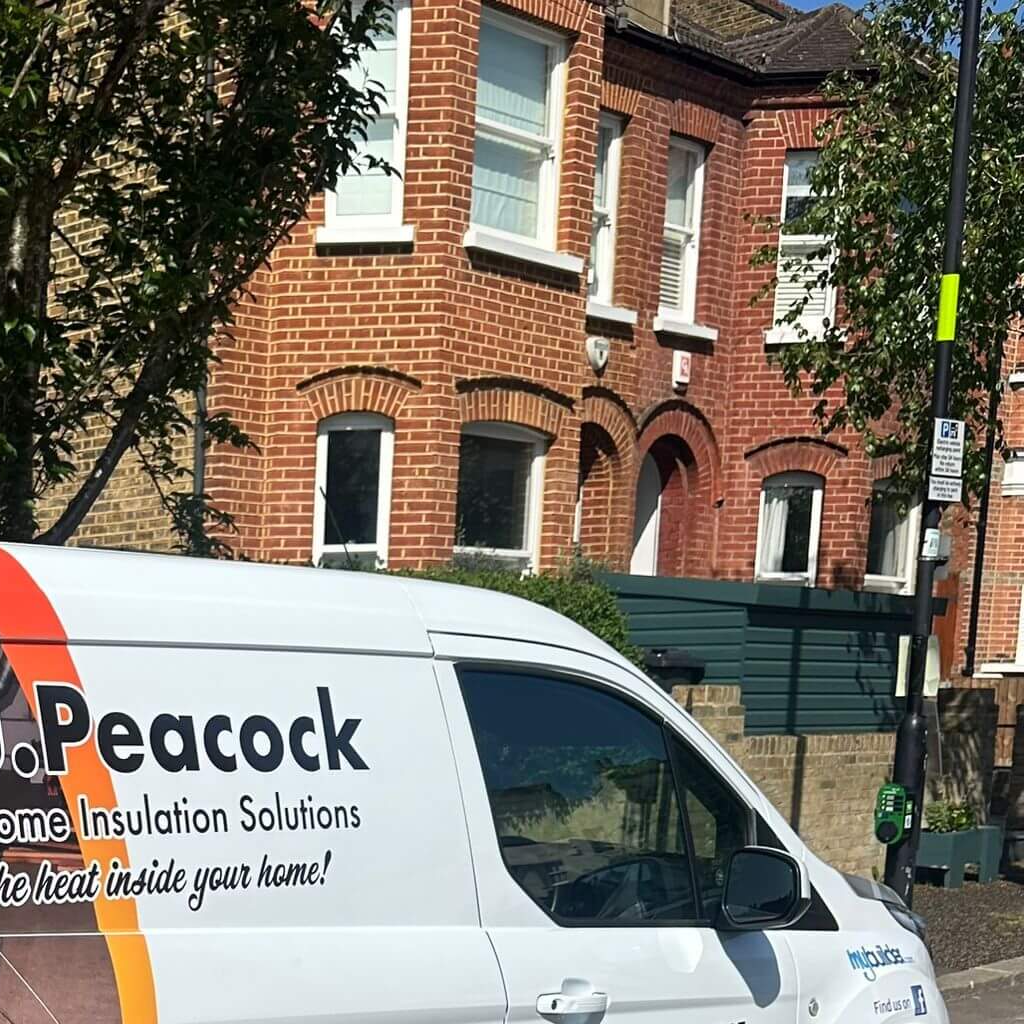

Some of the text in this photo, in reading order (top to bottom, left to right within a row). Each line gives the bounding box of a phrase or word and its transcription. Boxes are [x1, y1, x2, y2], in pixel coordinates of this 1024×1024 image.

[80, 795, 229, 838] Insulation
[240, 793, 362, 832] Solutions
[34, 861, 101, 905] heat
[105, 857, 186, 896] inside
[190, 866, 251, 911] your
[258, 851, 332, 888] home!
[873, 998, 892, 1014] Find
[892, 1000, 902, 1012] us
